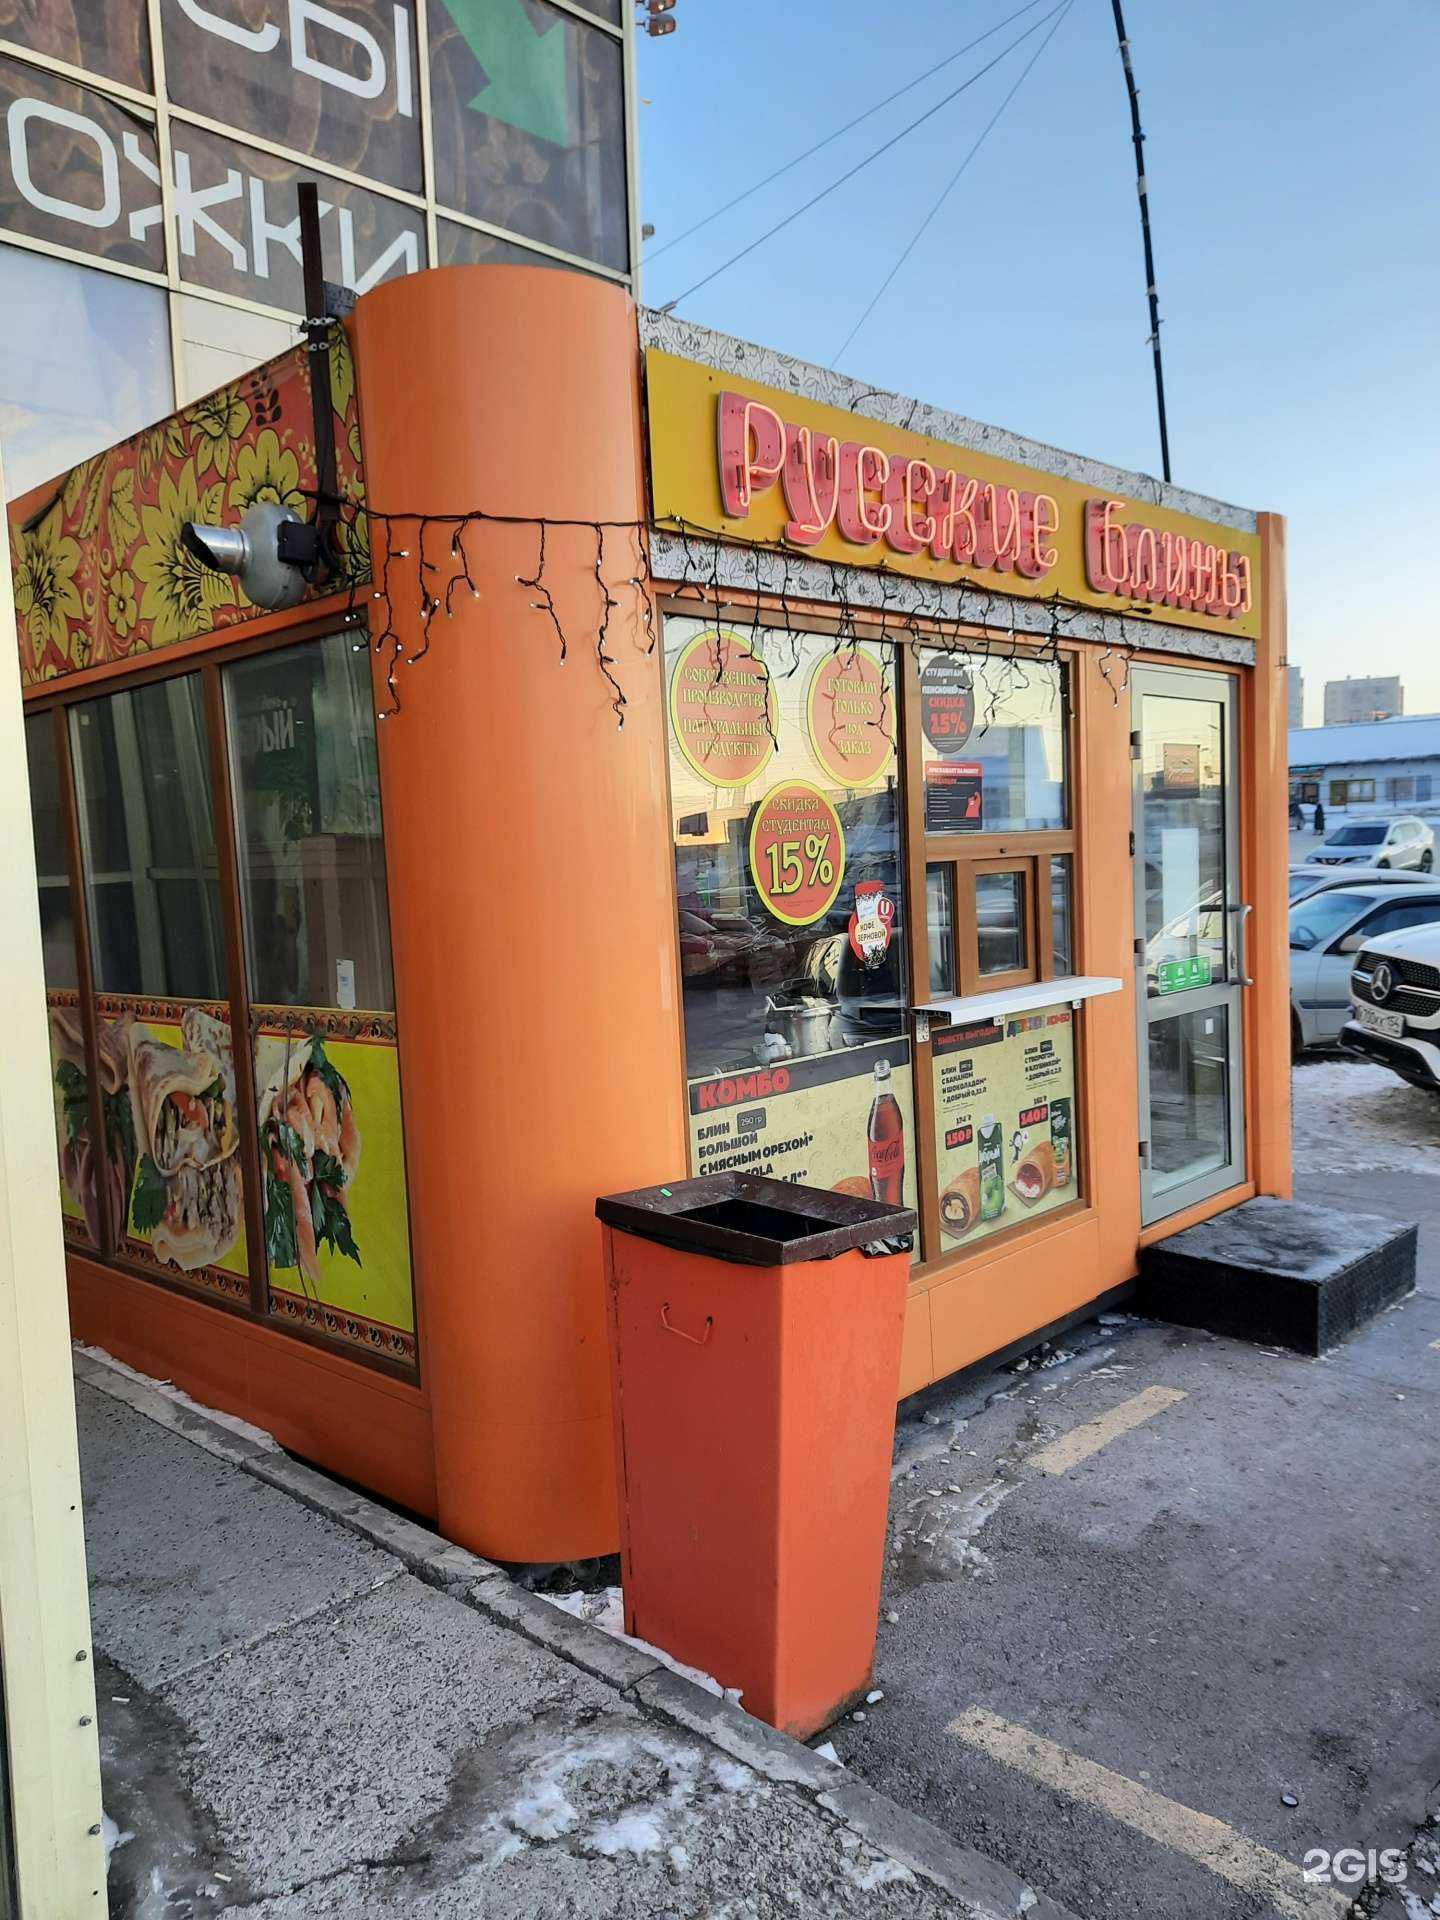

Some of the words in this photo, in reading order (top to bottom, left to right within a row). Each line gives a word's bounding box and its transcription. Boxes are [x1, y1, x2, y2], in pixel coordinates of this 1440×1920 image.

[828, 678, 877, 694] ГОТОВИМ
[835, 700, 873, 714] ТОЛЬКО
[930, 712, 967, 735] 15%
[697, 740, 761, 757] ПРОДУКТЫ
[838, 740, 872, 754] ЗАКАЗ
[773, 799, 819, 812] СКИДКА
[762, 818, 830, 834] СТУДЕНТАМ
[766, 834, 833, 894] 15%
[859, 921, 875, 931] КОФЕ
[699, 1067, 790, 1109] КОМБО
[698, 1121, 730, 1140] БЛИН
[699, 1131, 758, 1158] БОЛЬШОЙ
[708, 1149, 761, 1173] МЯСНЫМ
